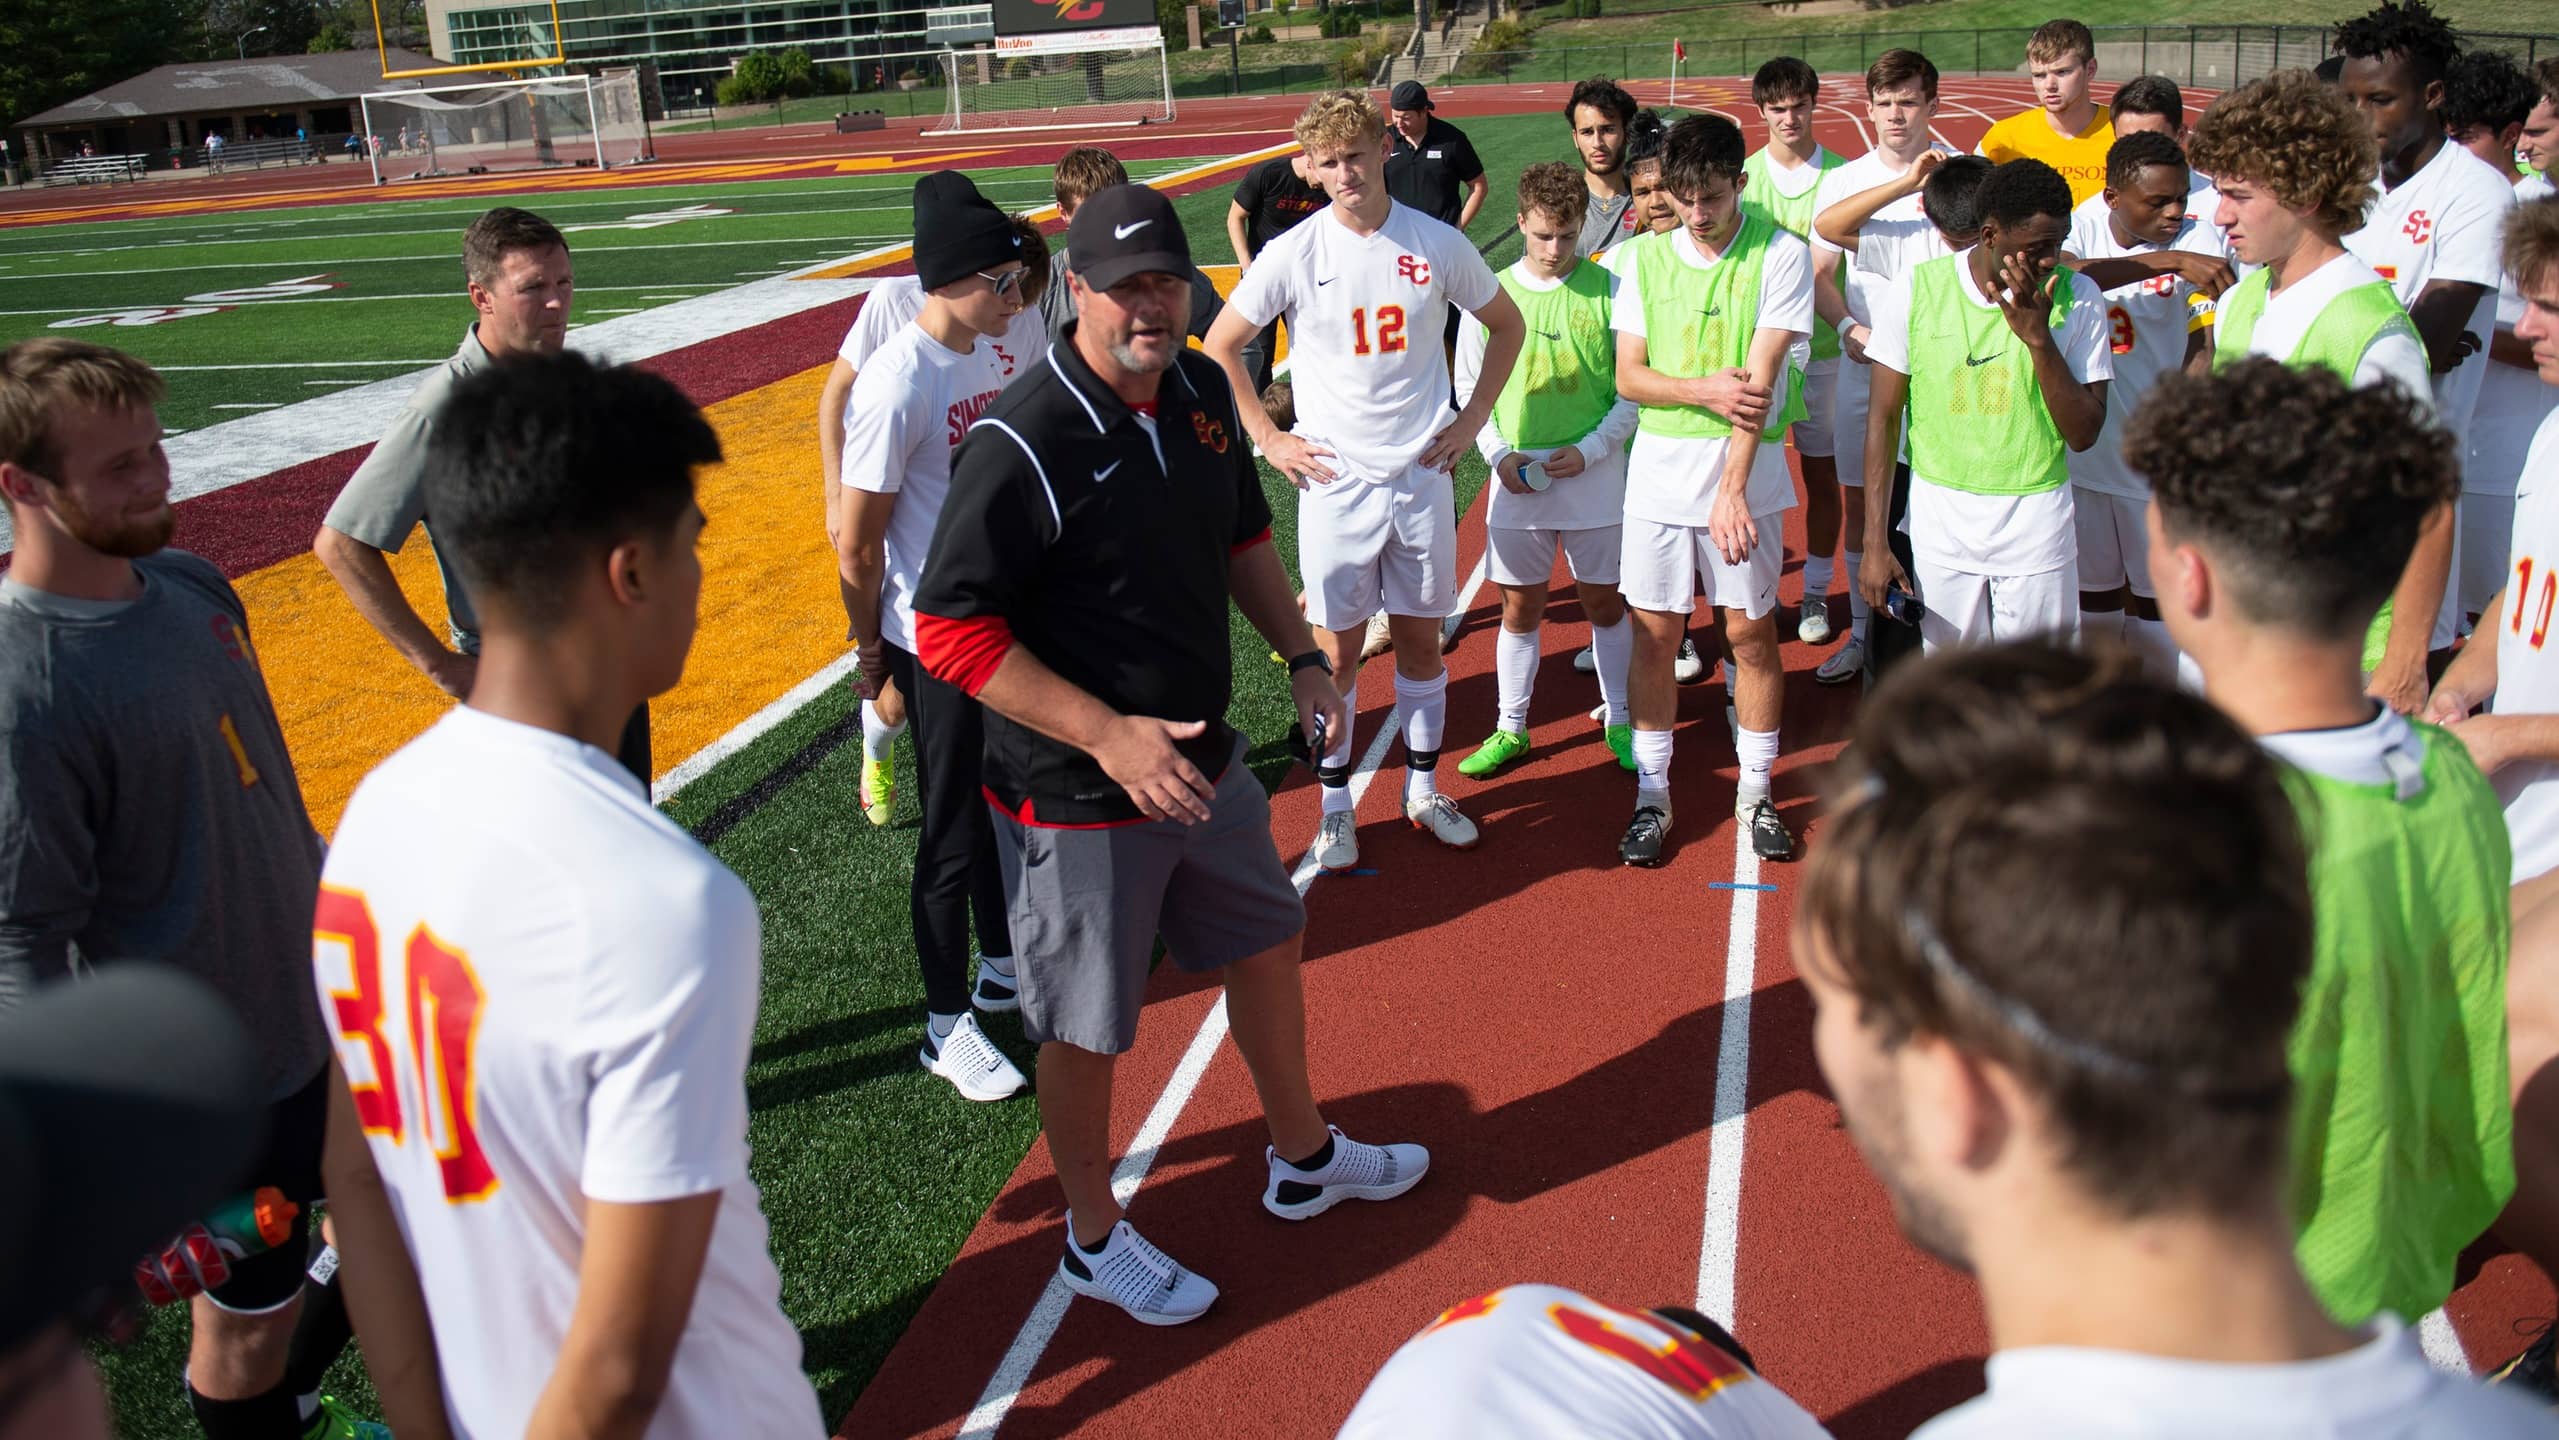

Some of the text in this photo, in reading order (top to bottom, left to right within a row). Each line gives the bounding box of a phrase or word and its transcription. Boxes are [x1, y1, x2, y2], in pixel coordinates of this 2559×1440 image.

[2403, 210, 2432, 245] SC
[1397, 254, 1432, 286] SC
[1351, 303, 1409, 357] 12
[2106, 304, 2136, 355] 3
[1191, 410, 1229, 454] SC
[2511, 555, 2557, 653] 10
[218, 712, 260, 790] 1
[312, 880, 502, 1206] 30
